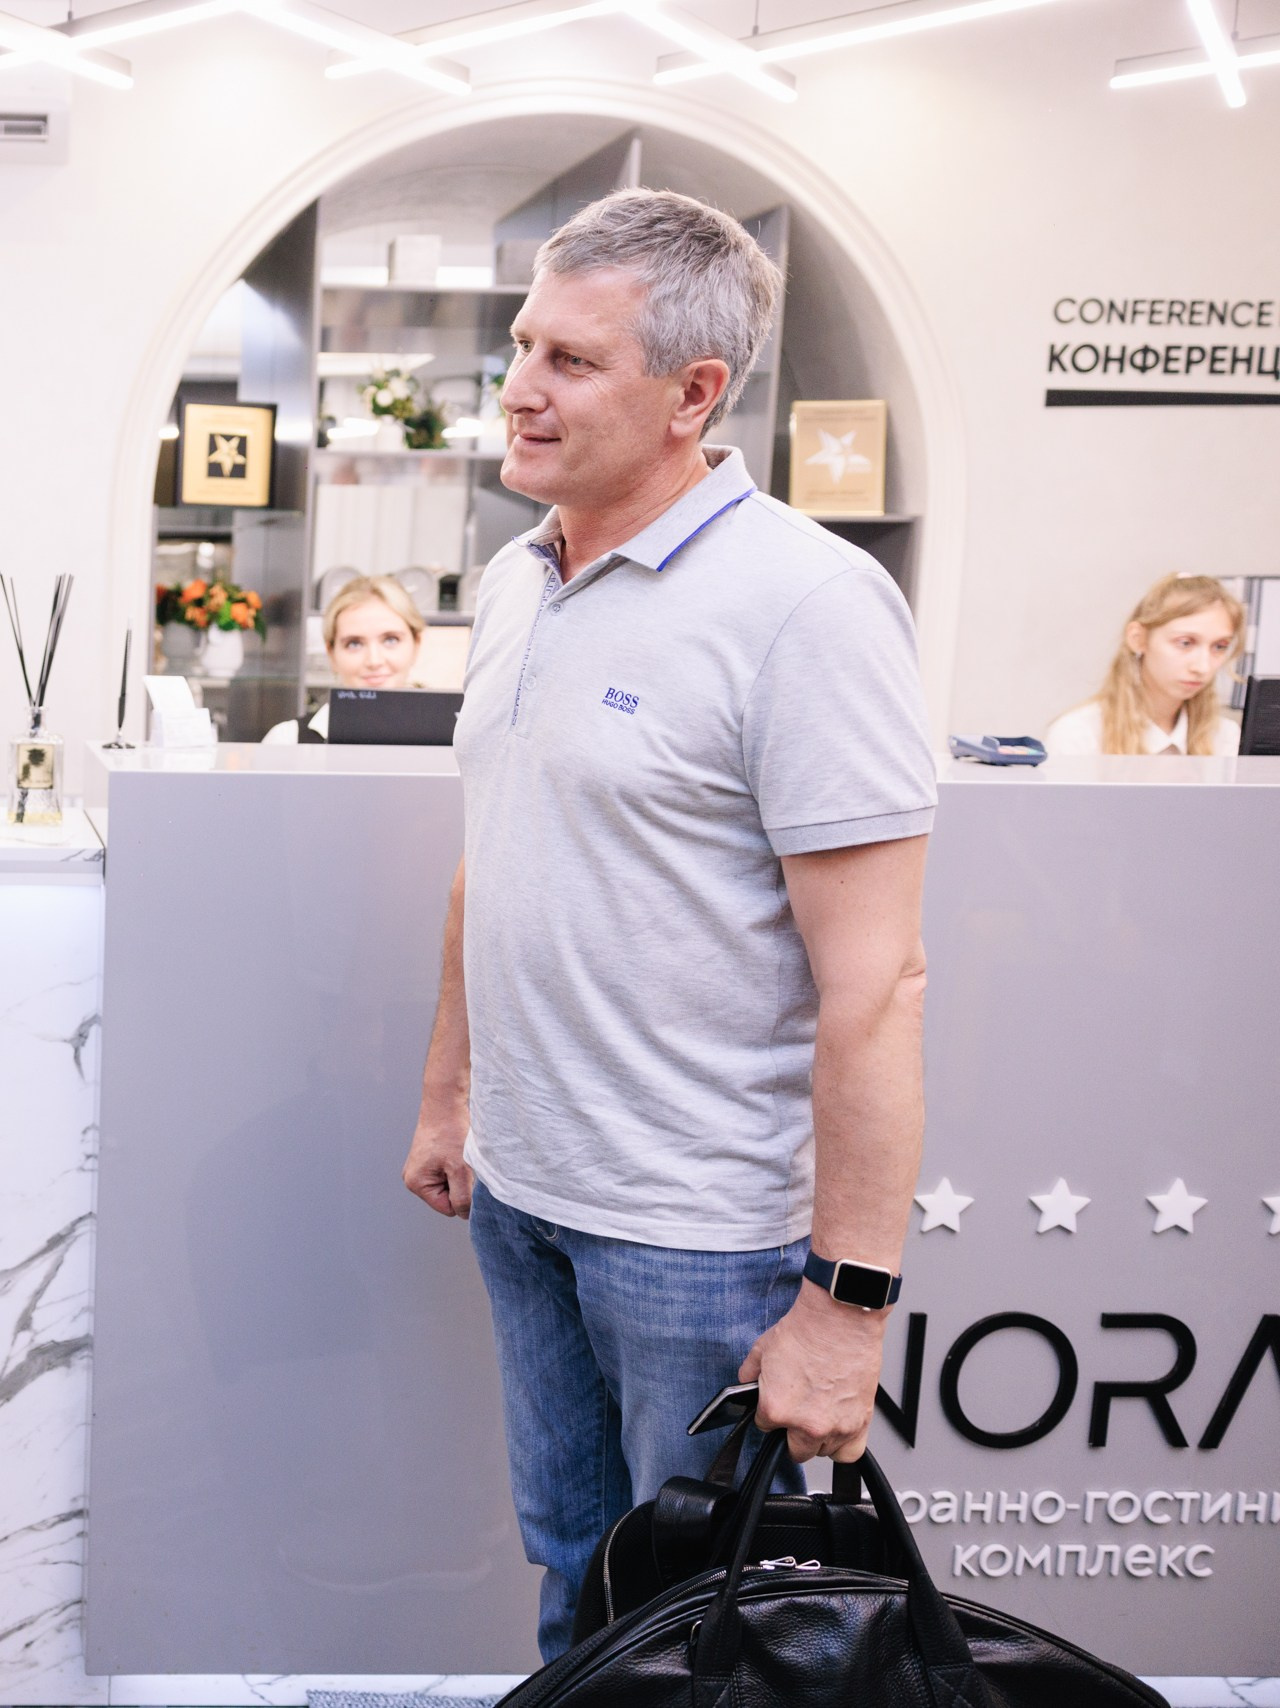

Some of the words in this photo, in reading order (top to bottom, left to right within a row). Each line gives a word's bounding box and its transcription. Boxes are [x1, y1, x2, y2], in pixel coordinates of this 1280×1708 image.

[1054, 298, 1274, 328] CONFERENCE
[1048, 343, 1280, 381] КОНФЕРЕНЦ
[605, 687, 639, 708] BOSS
[861, 1490, 1280, 1526] ранно-гостин
[954, 1543, 1215, 1578] комплекс
